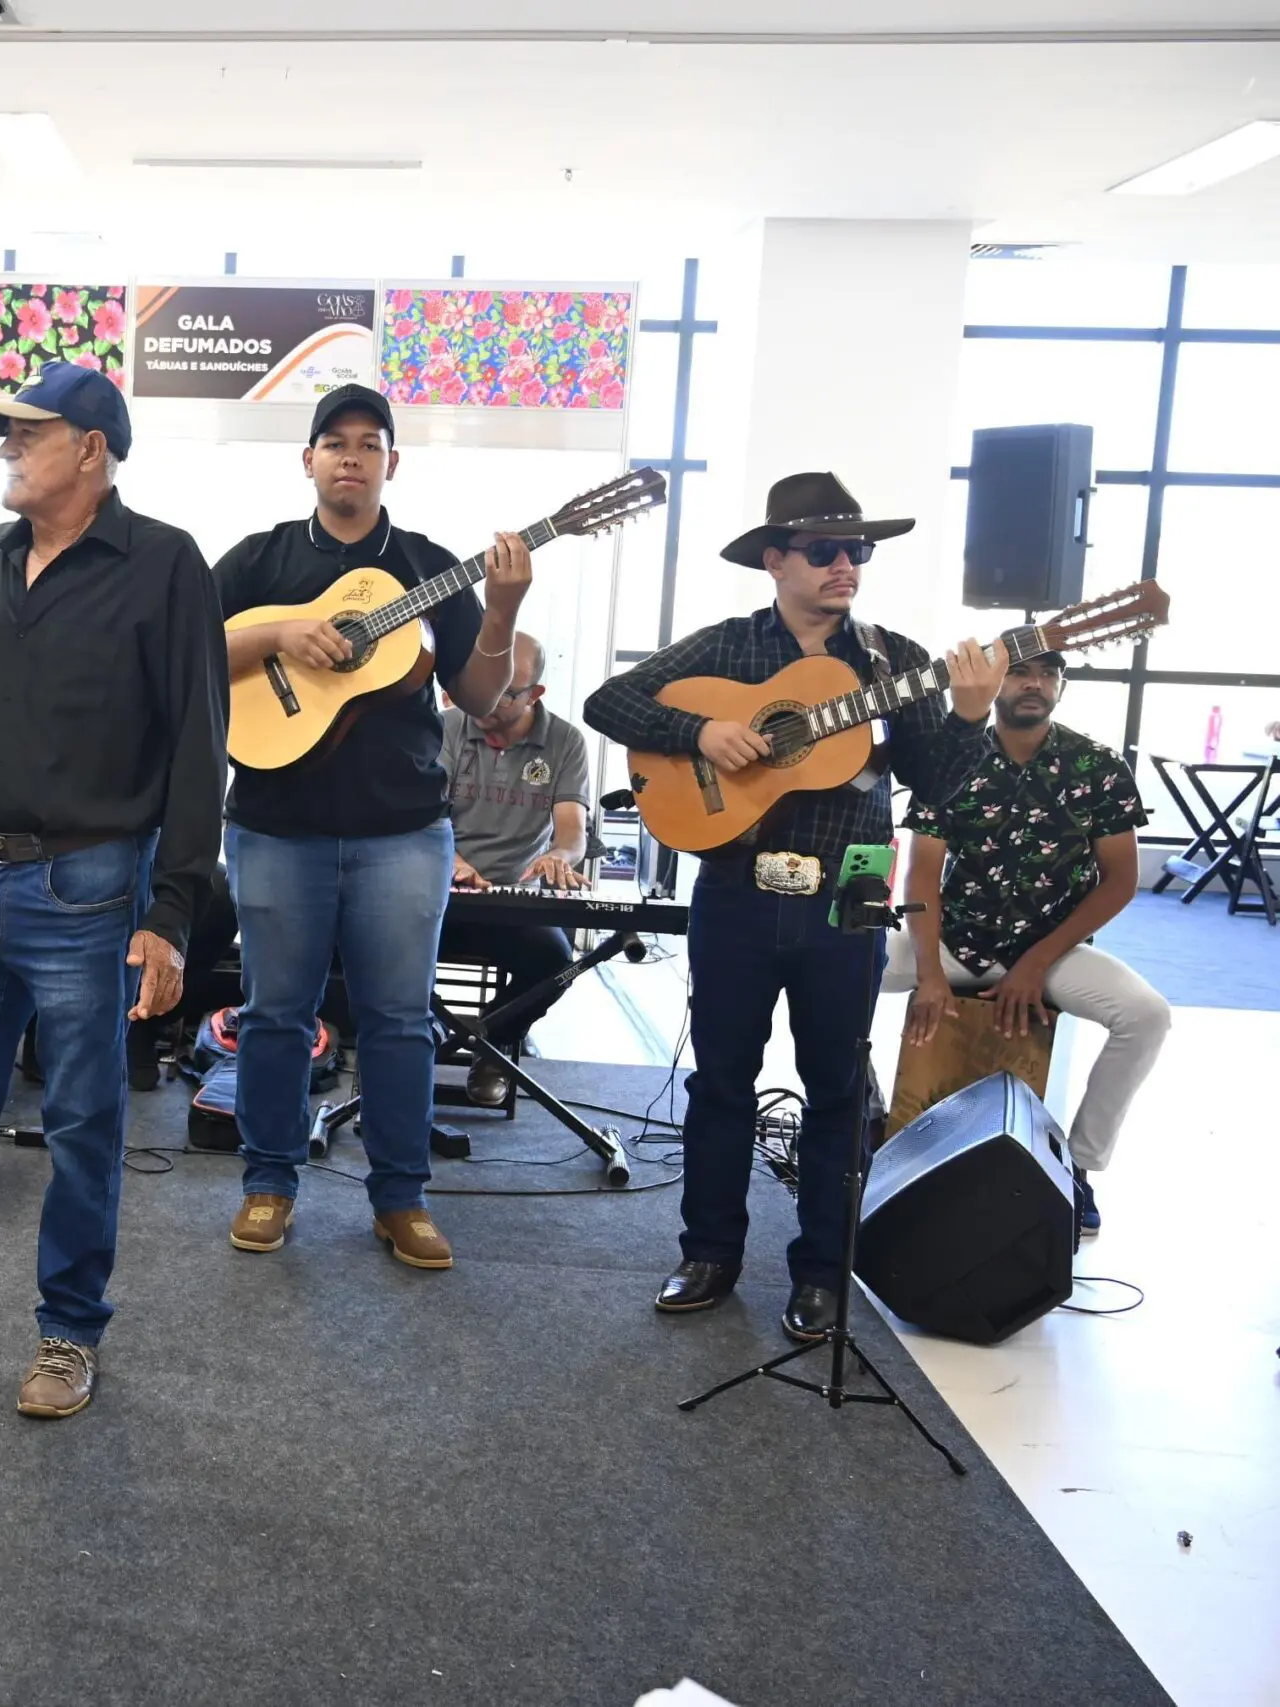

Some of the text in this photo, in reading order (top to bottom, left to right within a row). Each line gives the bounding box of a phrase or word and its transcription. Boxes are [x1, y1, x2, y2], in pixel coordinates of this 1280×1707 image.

[178, 314, 235, 331] GALA
[144, 337, 272, 355] DEFUMADOS
[145, 359, 270, 372] TÁBUAS E SANDUÍCHES
[585, 902, 634, 913] XPS-10
